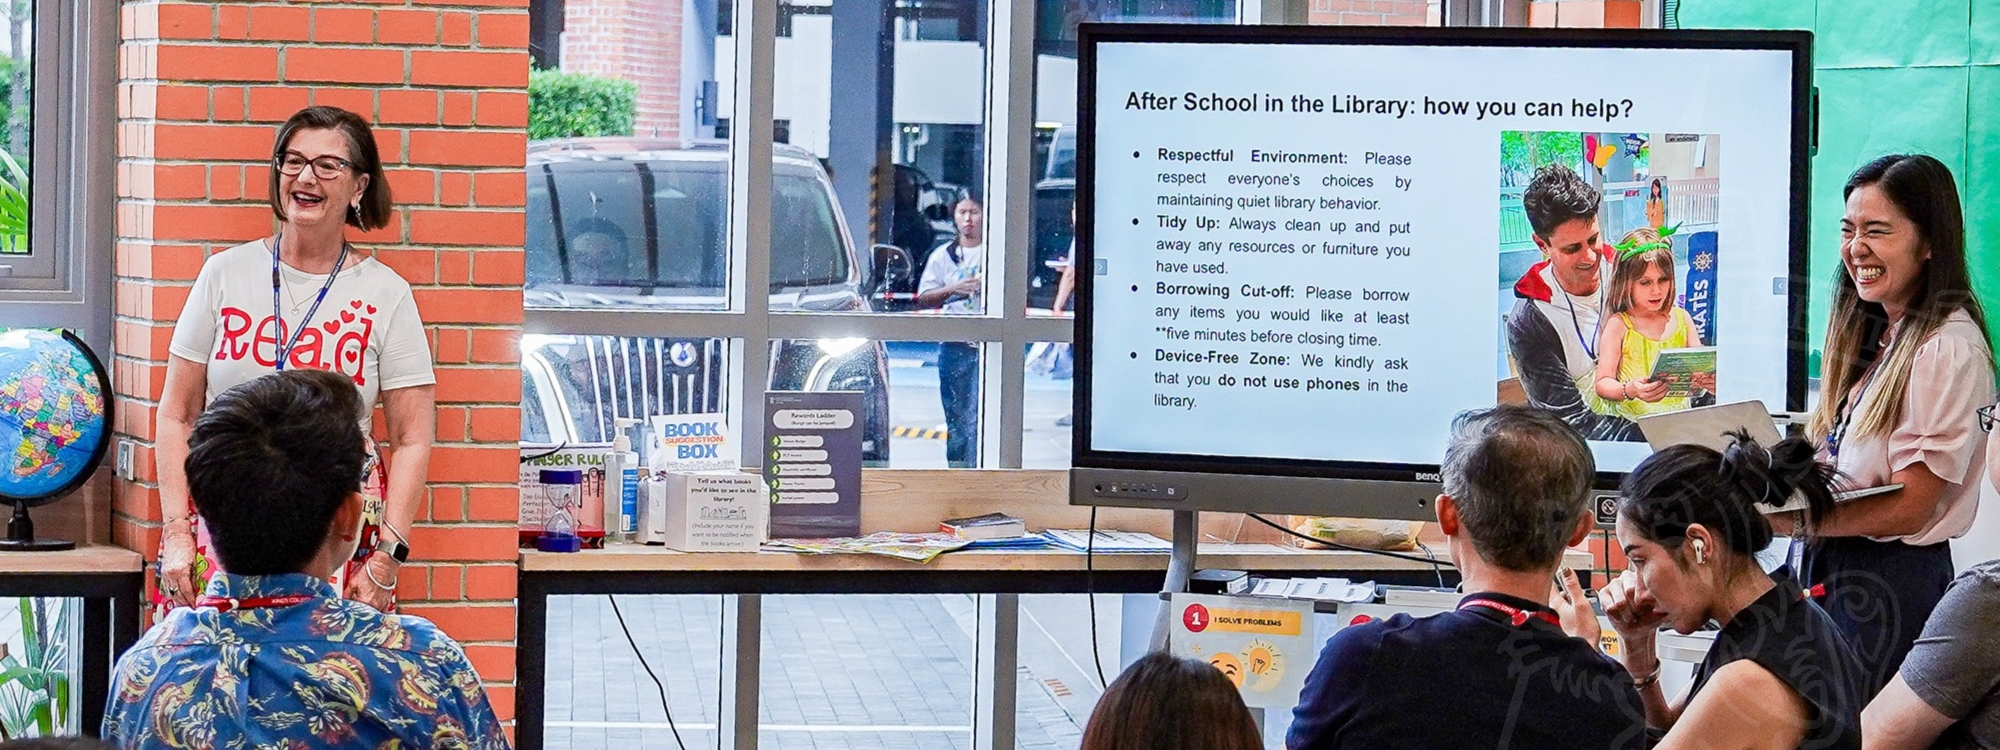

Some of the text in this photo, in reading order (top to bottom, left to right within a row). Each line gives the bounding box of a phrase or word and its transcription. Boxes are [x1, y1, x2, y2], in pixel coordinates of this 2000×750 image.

[1125, 91, 1633, 122] After School in the Library: how you can help?
[1158, 148, 1412, 166] Respectful Environment: Please
[1157, 172, 1412, 192] respect everyone's choices by
[1157, 193, 1381, 212] maintaining quiet library behavior.
[1156, 214, 1410, 236] Tidy Up: Always clean up and put
[1156, 240, 1410, 260] away any resources or furniture you
[1156, 260, 1228, 274] have used.
[1156, 281, 1410, 302] Borrowing Cut-off: Please borrow
[1155, 305, 1410, 325] any items you would like at least
[215, 306, 373, 387] Read
[1194, 328, 1246, 342] minutes
[1250, 329, 1293, 344] before
[1297, 331, 1344, 349] closing
[1349, 332, 1381, 347] time.
[1155, 348, 1408, 372] Device-Free Zone: We kindly ask
[1154, 371, 1408, 393] that you do not use phones in the
[1154, 393, 1197, 411] library.
[664, 422, 720, 438] BOOK
[665, 436, 724, 444] SUGGESTION
[577, 453, 606, 466] RUL
[678, 444, 718, 459] BOX
[1415, 472, 1442, 482] BenQ
[1192, 612, 1202, 626] 1
[1218, 616, 1242, 624] SOLVE
[1244, 618, 1282, 626] PROBLEMS
